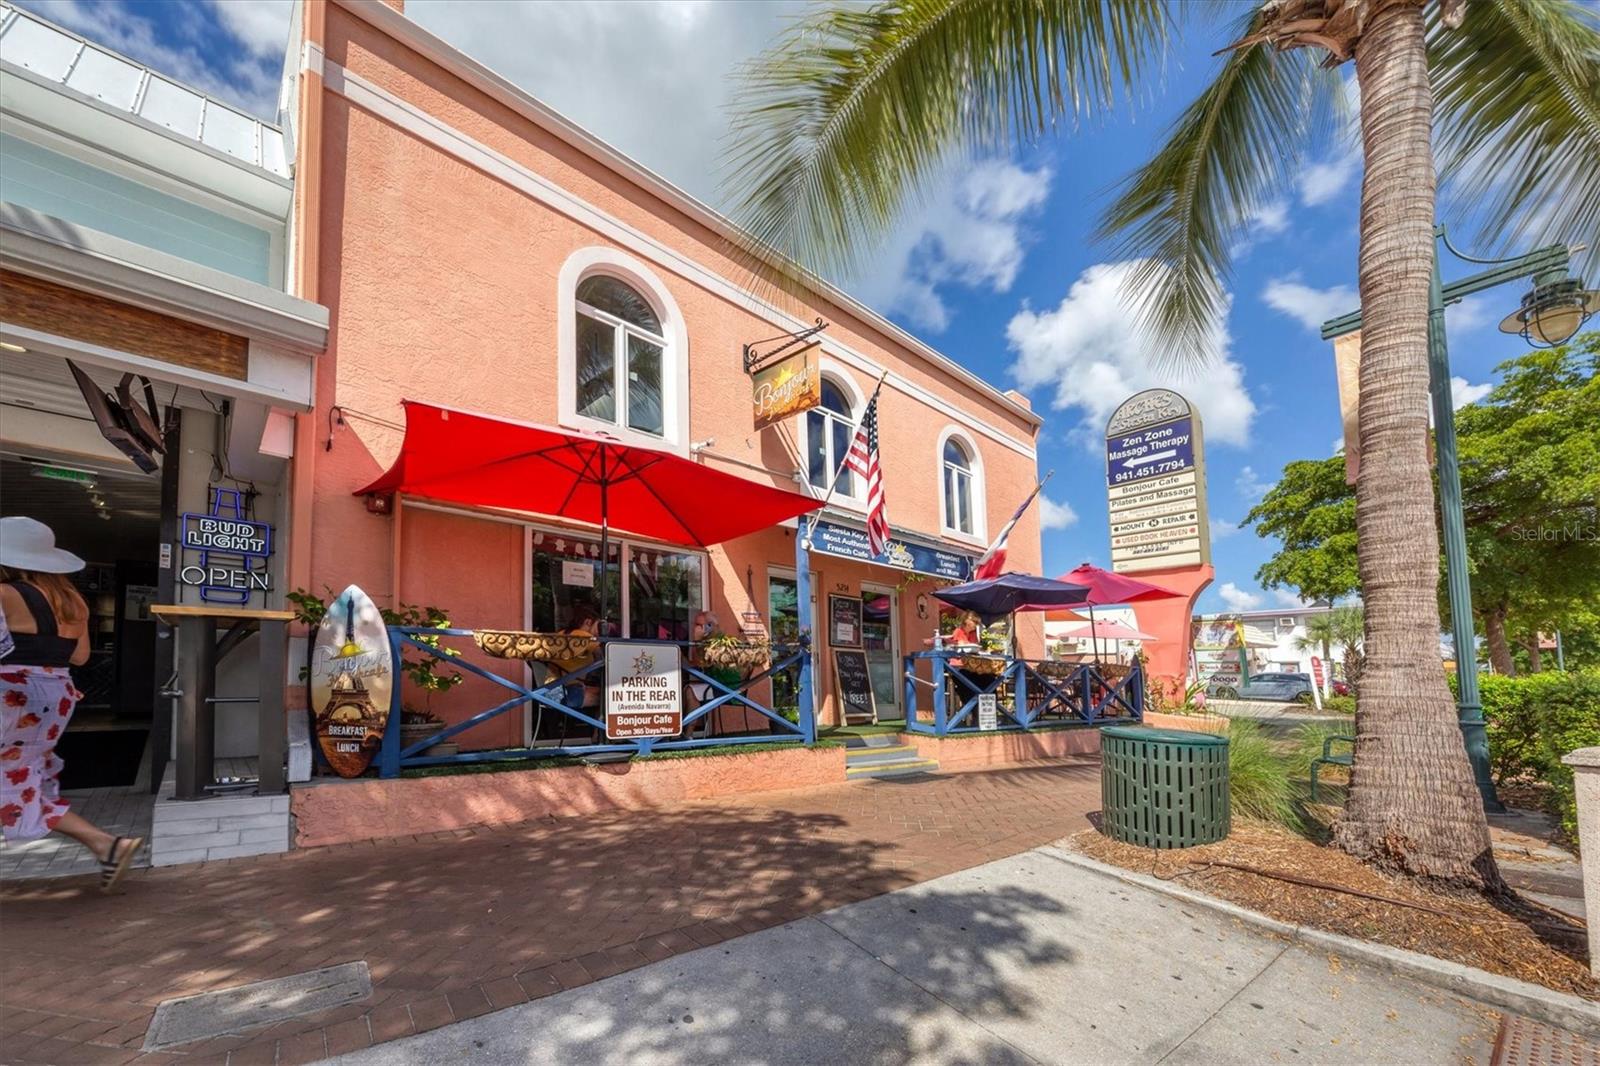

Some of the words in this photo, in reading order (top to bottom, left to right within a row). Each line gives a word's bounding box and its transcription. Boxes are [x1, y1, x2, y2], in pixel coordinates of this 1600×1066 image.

[1122, 436, 1142, 448] Zen
[1145, 428, 1173, 442] Zone
[1109, 445, 1148, 461] Massage
[1149, 434, 1189, 450] Therapy
[1115, 458, 1185, 482] 941.451.7794
[1122, 482, 1157, 494] Bonjour
[1158, 476, 1180, 487] Cafe
[1111, 497, 1138, 508] Pilates
[1138, 493, 1155, 503] and
[1156, 487, 1194, 499] Massage
[1162, 514, 1187, 525] REPAIR
[200, 518, 254, 538] BUD
[187, 530, 265, 552] LIGHT
[823, 533, 842, 544] Most
[1121, 535, 1139, 545] USED
[1140, 532, 1159, 542] BOOK
[1160, 528, 1188, 539] HEAVEN
[827, 543, 852, 556] French
[852, 549, 869, 559] Cafe
[181, 565, 268, 591] OPEN
[621, 676, 668, 688] PARKING
[612, 690, 623, 702] IN
[626, 690, 646, 702] THE
[649, 690, 677, 702] REAR
[617, 703, 645, 711] (Avenida
[646, 702, 672, 711] Navarra)
[617, 714, 651, 727] Bonjour
[653, 714, 673, 725] Cafe
[328, 725, 368, 736] BREAKFAST
[616, 728, 632, 737] Open
[633, 727, 645, 736] 365
[336, 742, 360, 753] LUNCH
